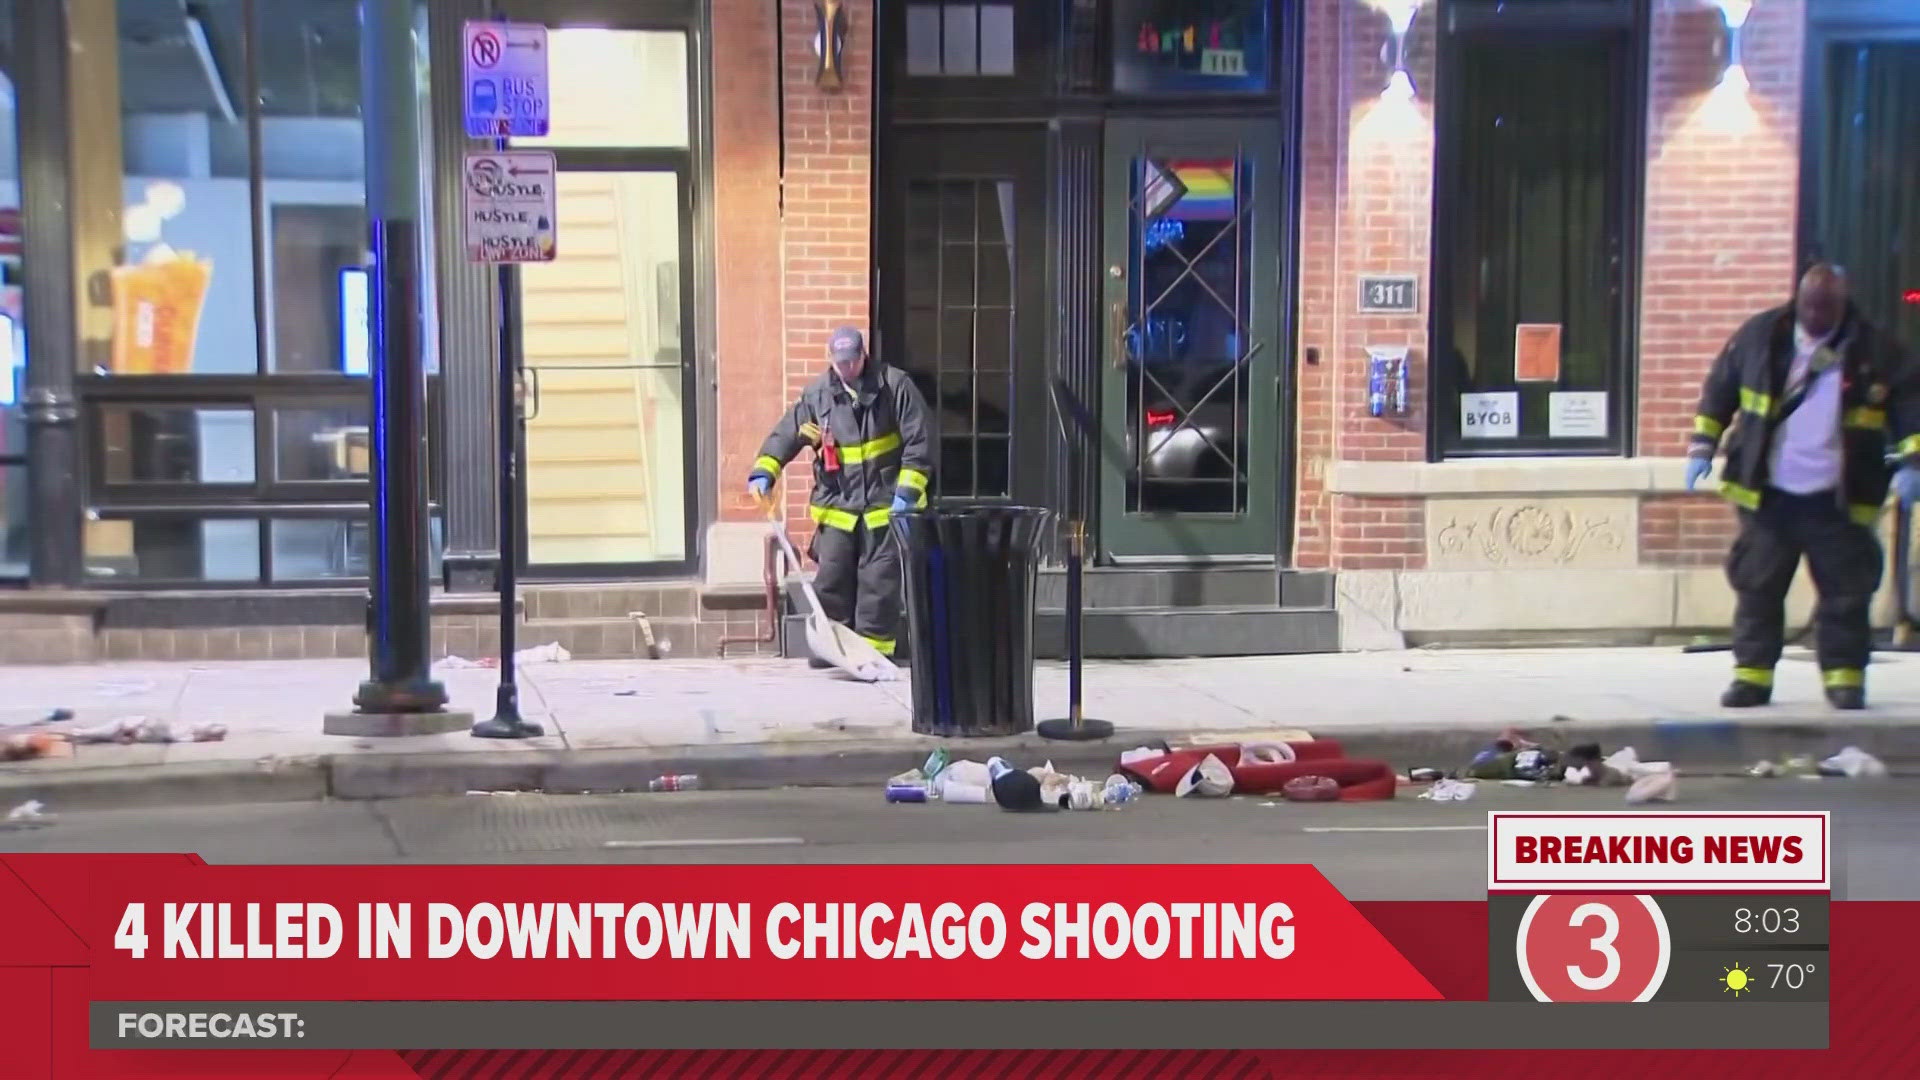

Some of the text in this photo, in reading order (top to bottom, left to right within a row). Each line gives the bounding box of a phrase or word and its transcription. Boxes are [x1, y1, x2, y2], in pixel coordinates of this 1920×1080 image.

[503, 79, 534, 96] BUS
[503, 98, 543, 115] STOP
[1373, 284, 1405, 305] 311
[1466, 411, 1511, 426] BYOB
